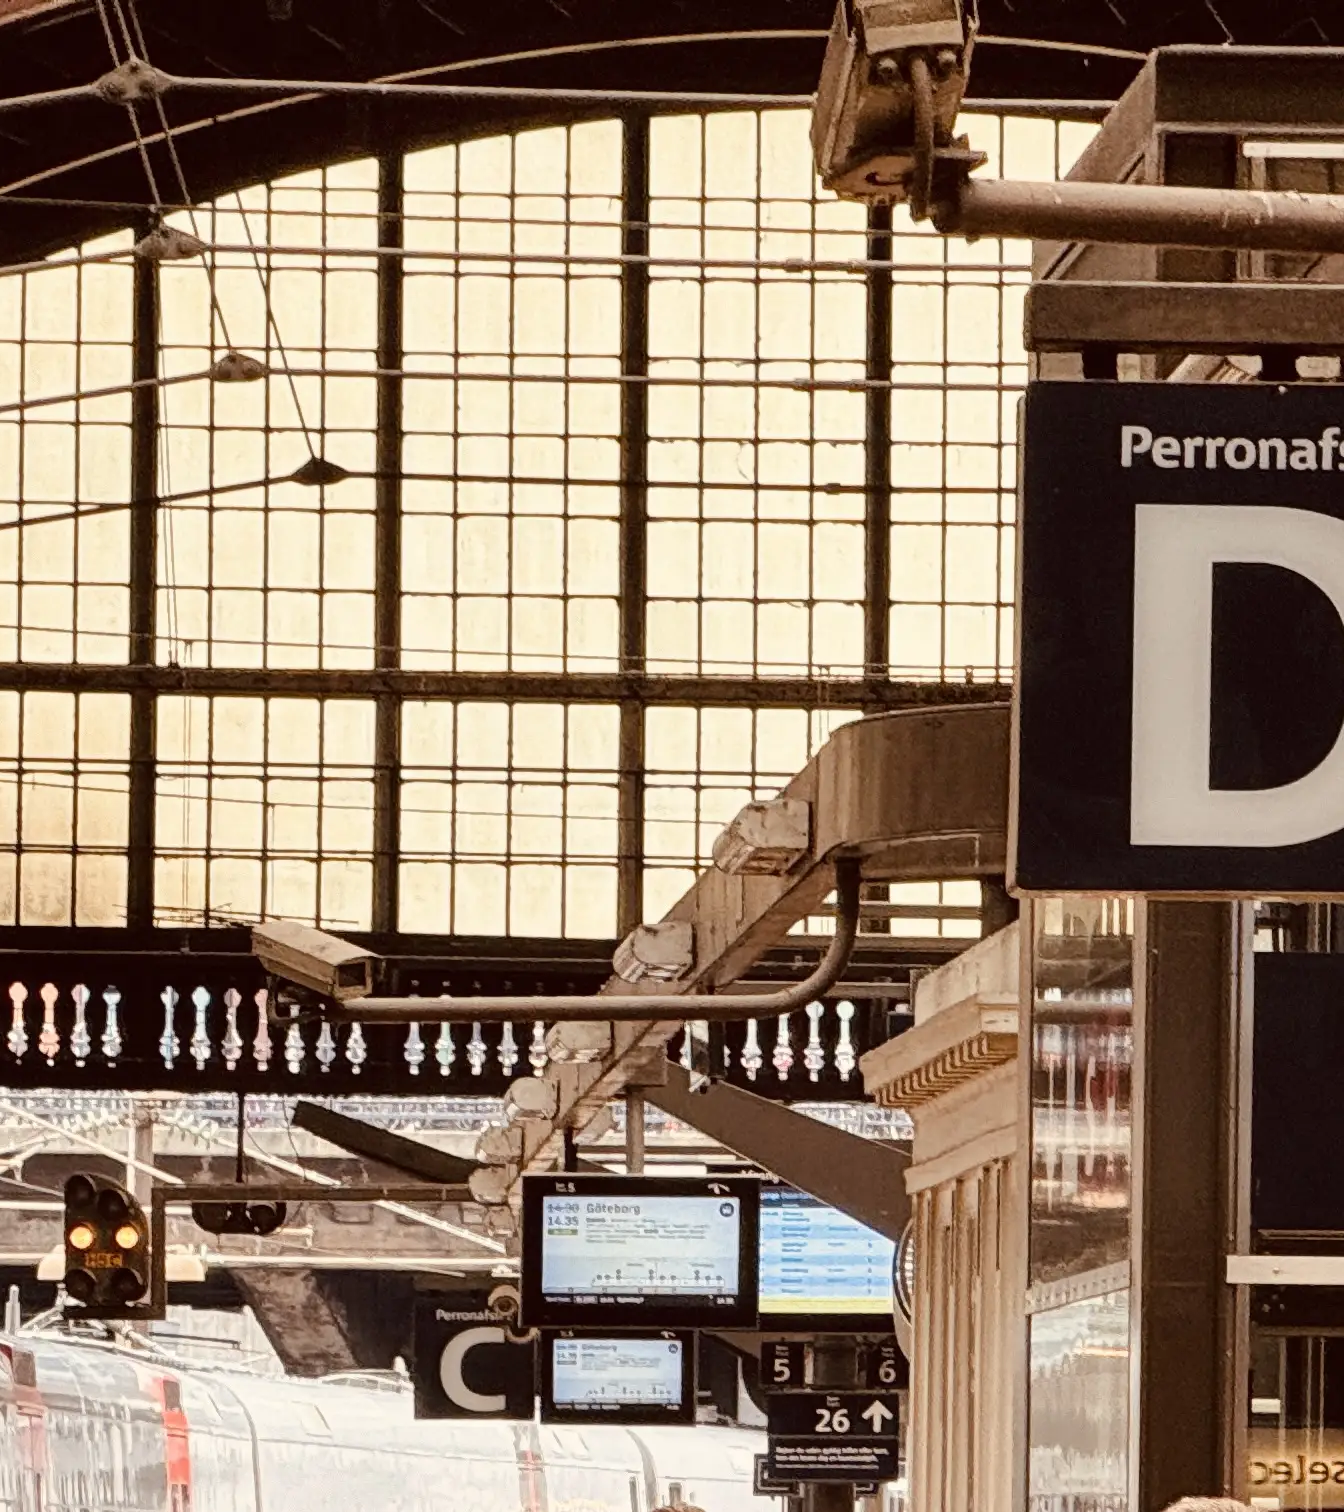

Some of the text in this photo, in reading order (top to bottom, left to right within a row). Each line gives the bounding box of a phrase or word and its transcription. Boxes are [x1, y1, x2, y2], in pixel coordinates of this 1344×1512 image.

[586, 1203, 640, 1216] Göteborg
[436, 1308, 502, 1321] Perronafs
[440, 1326, 507, 1412] C
[773, 1358, 791, 1383] 5
[879, 1359, 897, 1384] 6
[815, 1408, 851, 1434] 26
